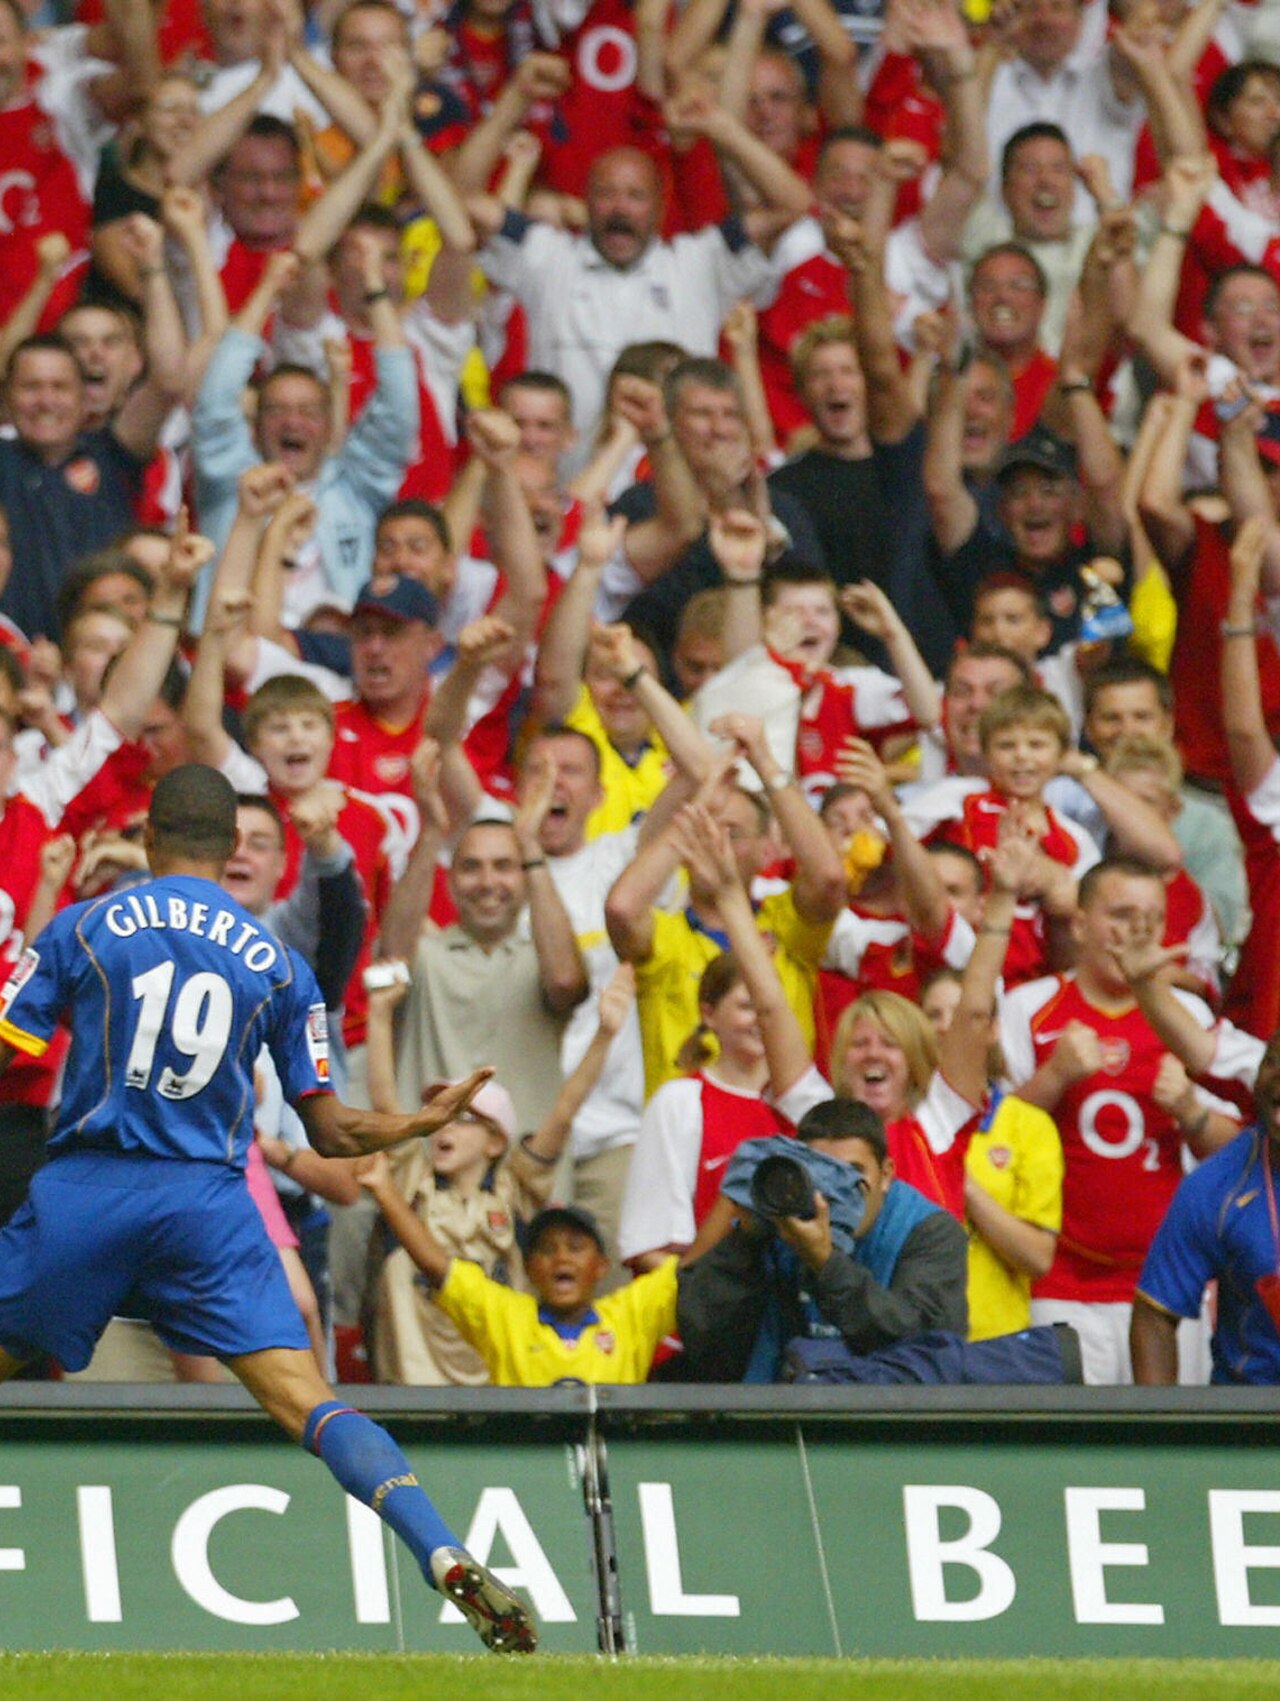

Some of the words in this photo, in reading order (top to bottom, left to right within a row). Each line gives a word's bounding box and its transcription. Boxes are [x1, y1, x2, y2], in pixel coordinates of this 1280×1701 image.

[105, 894, 278, 973] GILBERTO
[124, 959, 234, 1101] 19
[1078, 1088, 1160, 1172] O2
